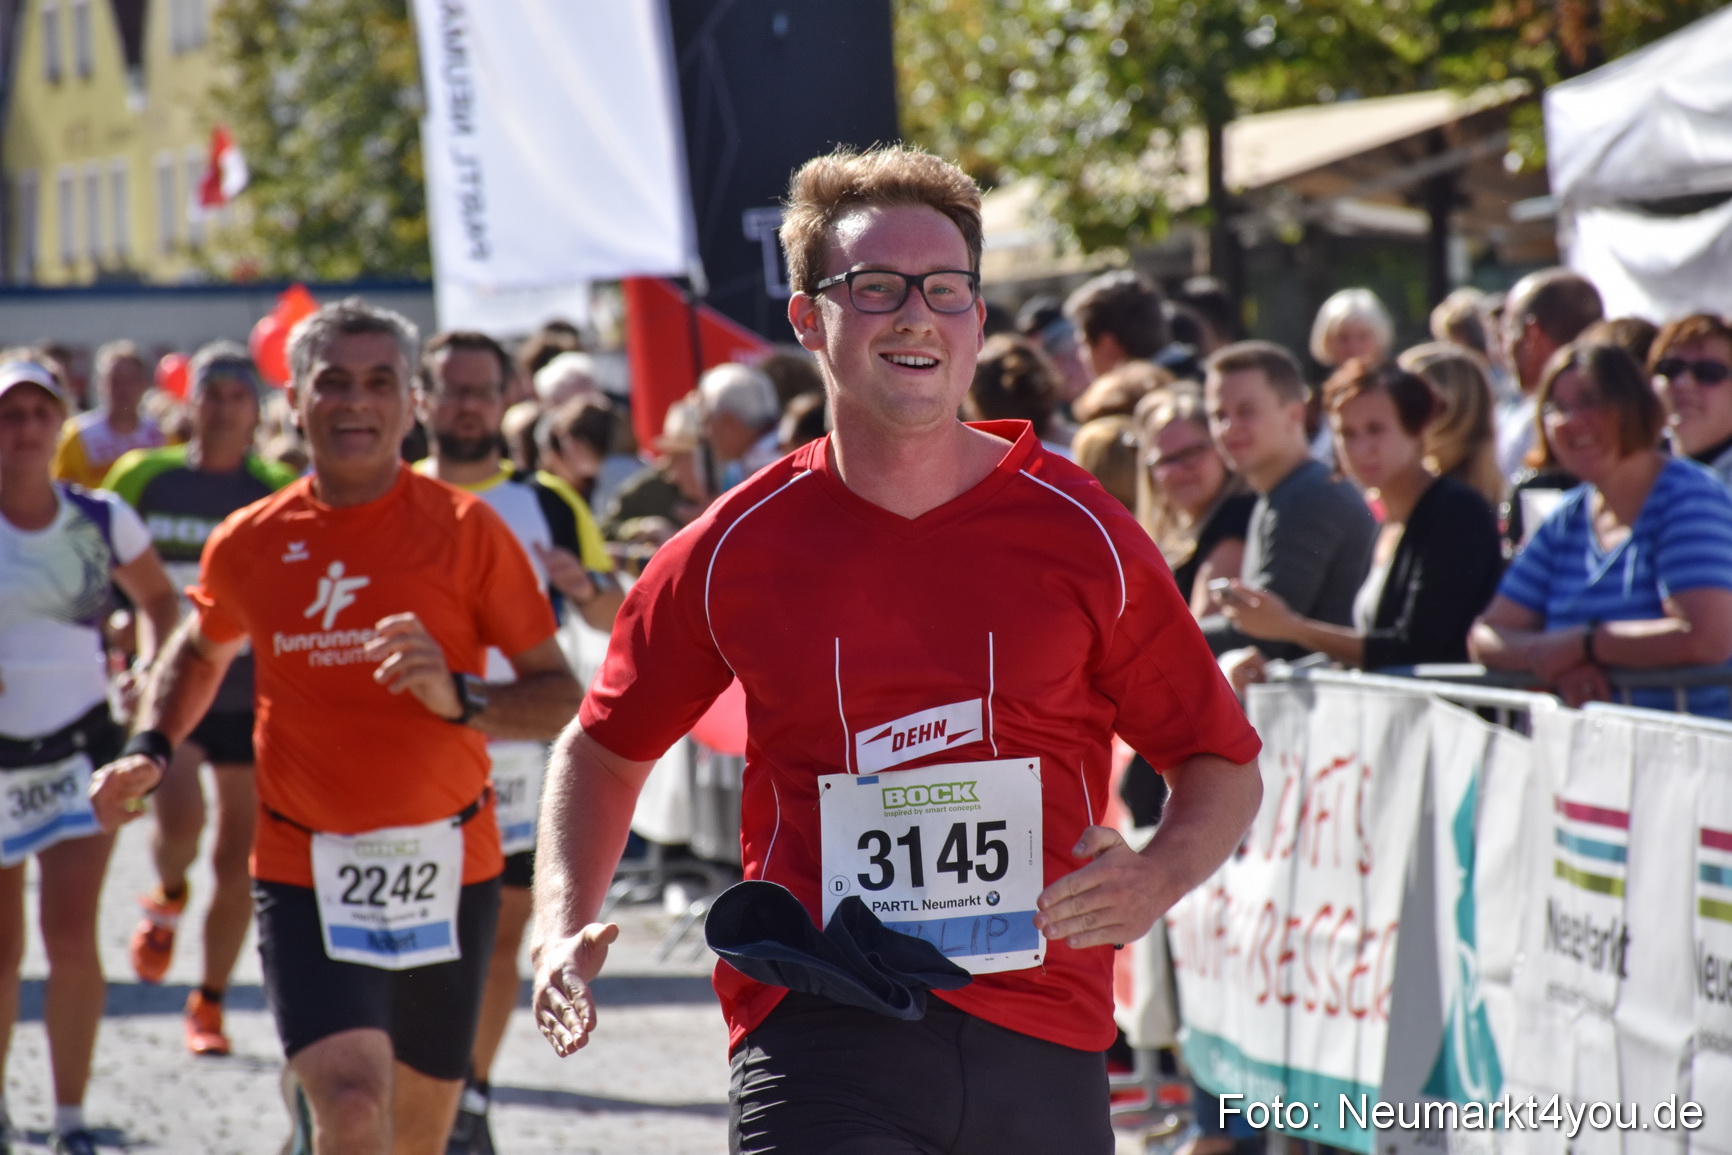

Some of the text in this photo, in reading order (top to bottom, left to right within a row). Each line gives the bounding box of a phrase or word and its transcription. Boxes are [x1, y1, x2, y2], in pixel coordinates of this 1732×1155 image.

[891, 718, 948, 753] DEHN
[882, 781, 980, 809] BOCK
[884, 803, 981, 818] inspired by smart concepts
[857, 820, 1009, 891] 3145
[338, 861, 438, 906] 2242
[835, 881, 843, 891] D
[872, 895, 982, 913] PARTL Neumarkt
